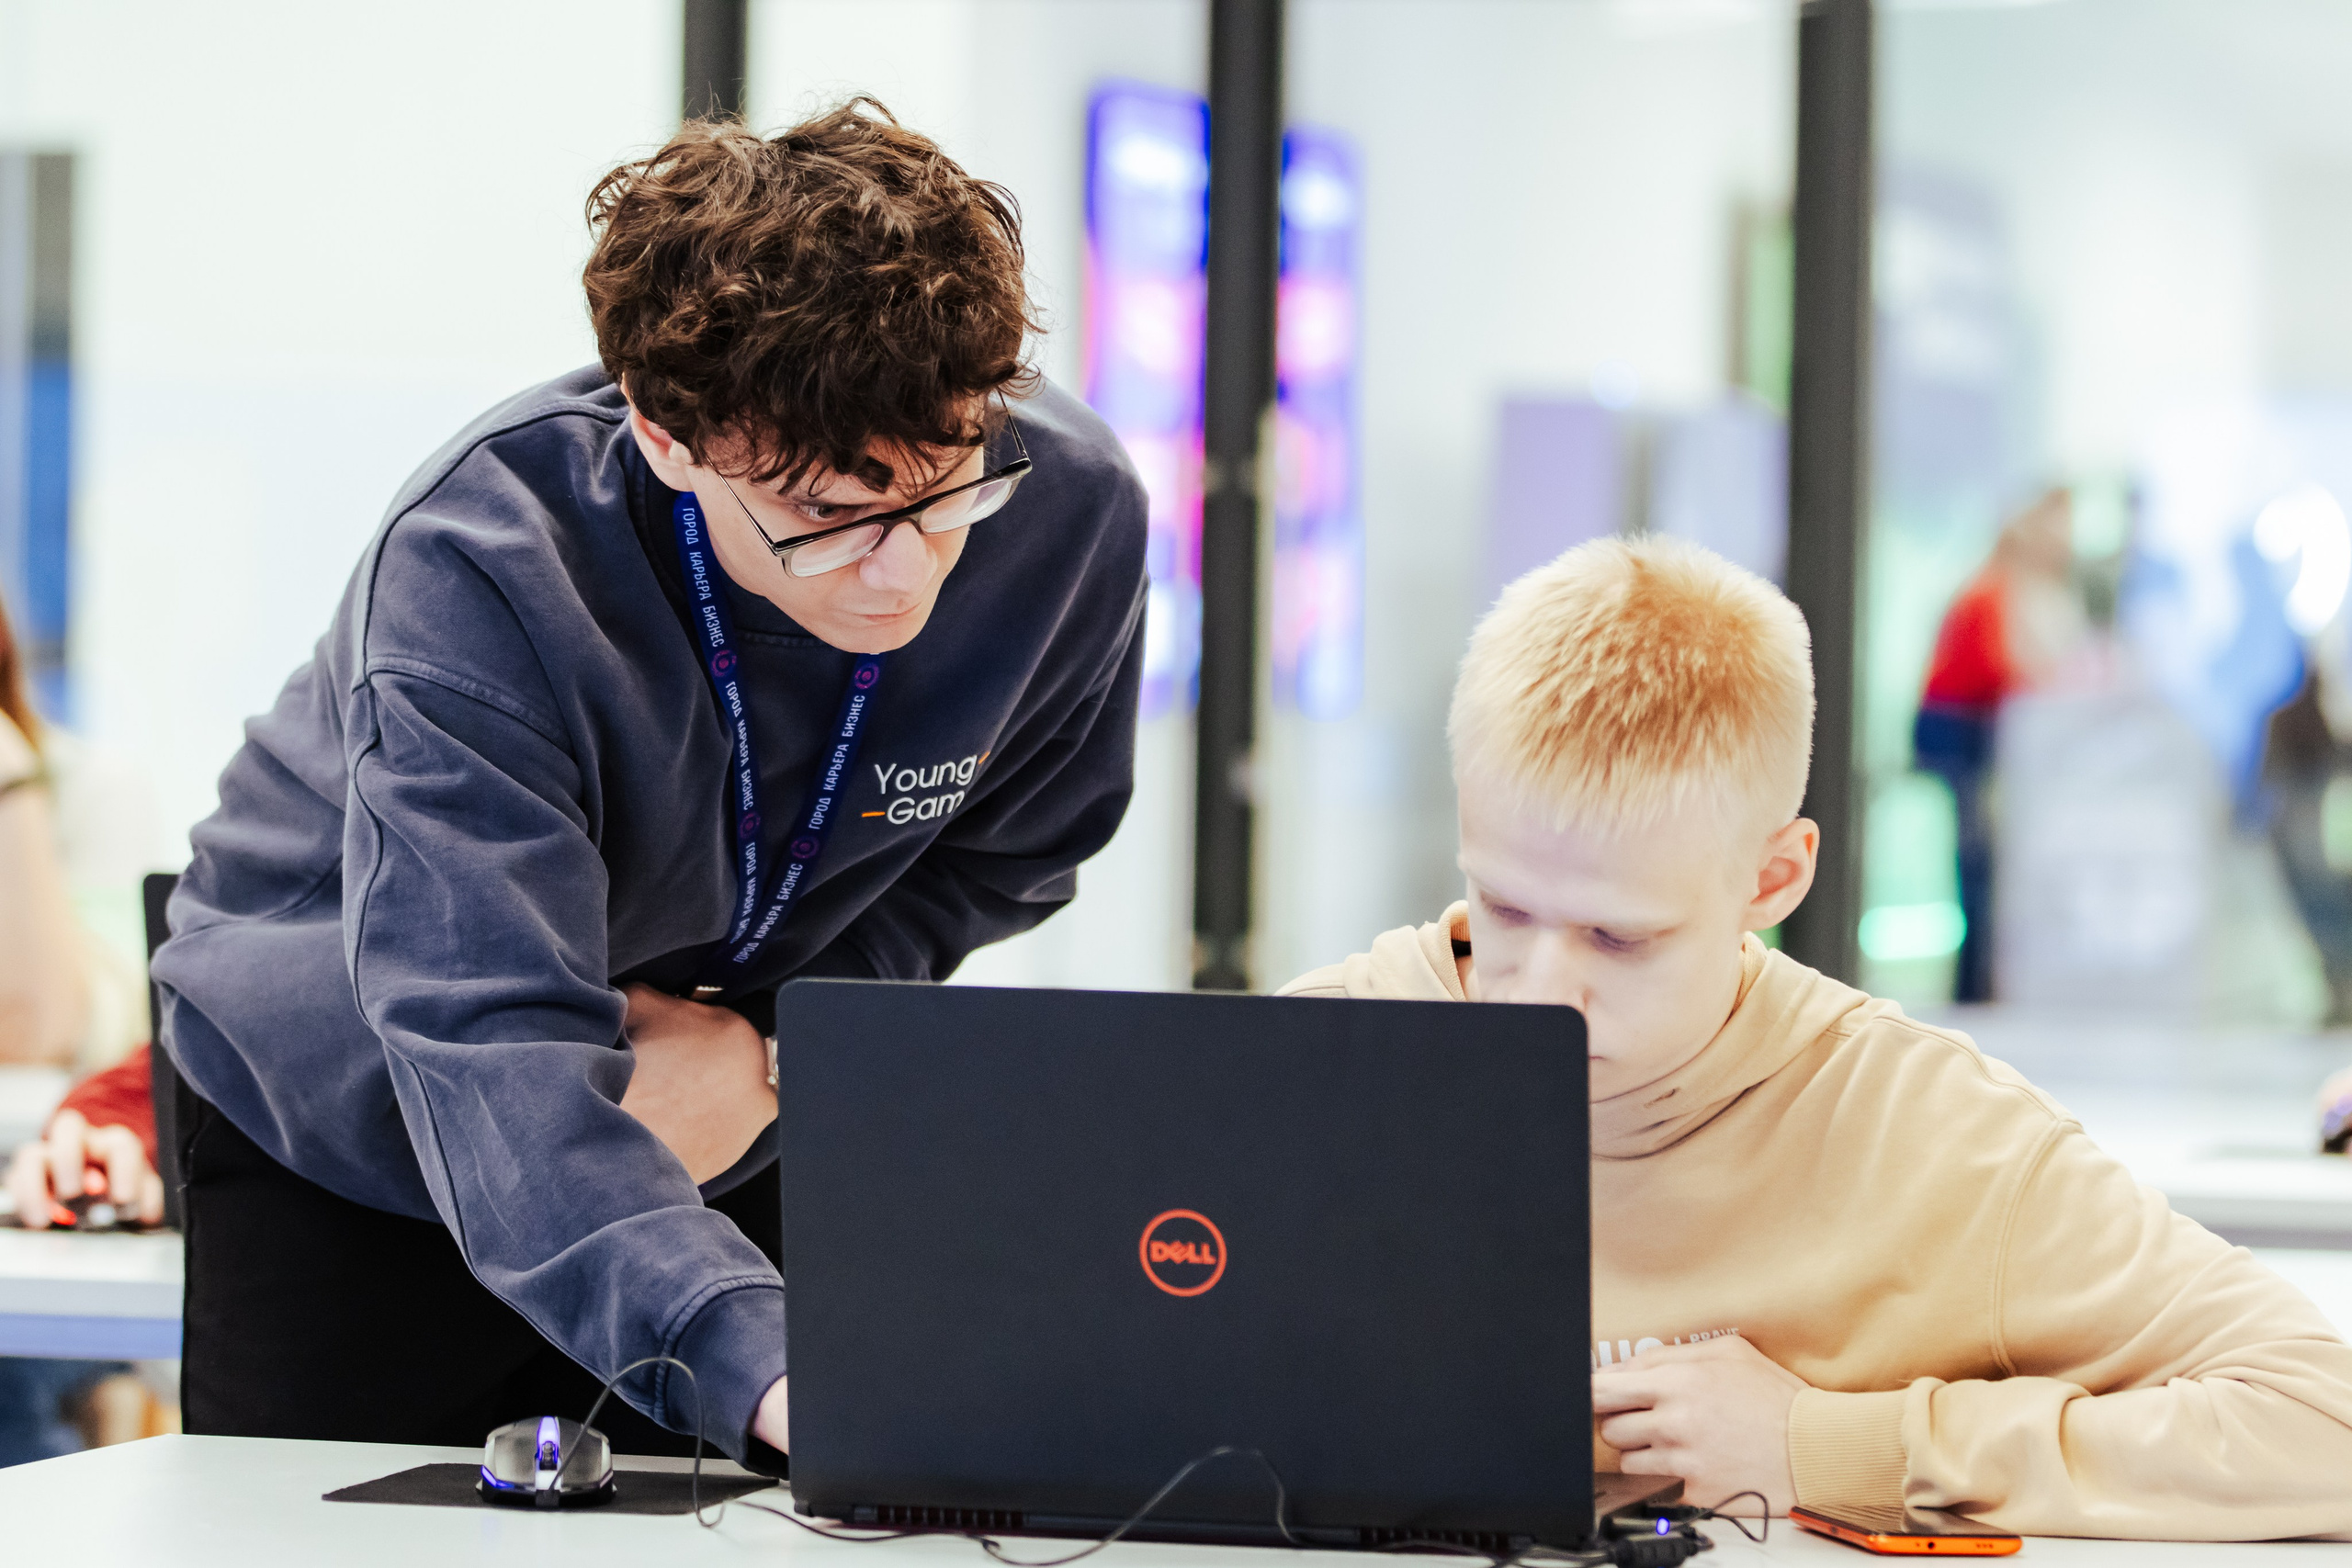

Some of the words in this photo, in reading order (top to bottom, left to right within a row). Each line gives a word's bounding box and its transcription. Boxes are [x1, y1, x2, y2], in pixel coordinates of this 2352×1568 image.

[683, 508, 699, 545] ГОРОД
[689, 552, 712, 601] КАРЬЕРА
[702, 605, 725, 647] БИЗНЕС
[725, 681, 742, 717] ГОРОД
[737, 719, 749, 767] КАРЬЕРА
[808, 797, 831, 830] ГОРОД
[823, 743, 849, 791] КАРЬЕРА
[842, 694, 865, 738] БИЗНЕС
[741, 769, 753, 810] БИЗНЕС
[732, 942, 760, 964] ГОРОД
[753, 905, 784, 939] КАРЬЕРА
[776, 863, 804, 900] БИЗНЕС
[1149, 1240, 1217, 1265] DELL
